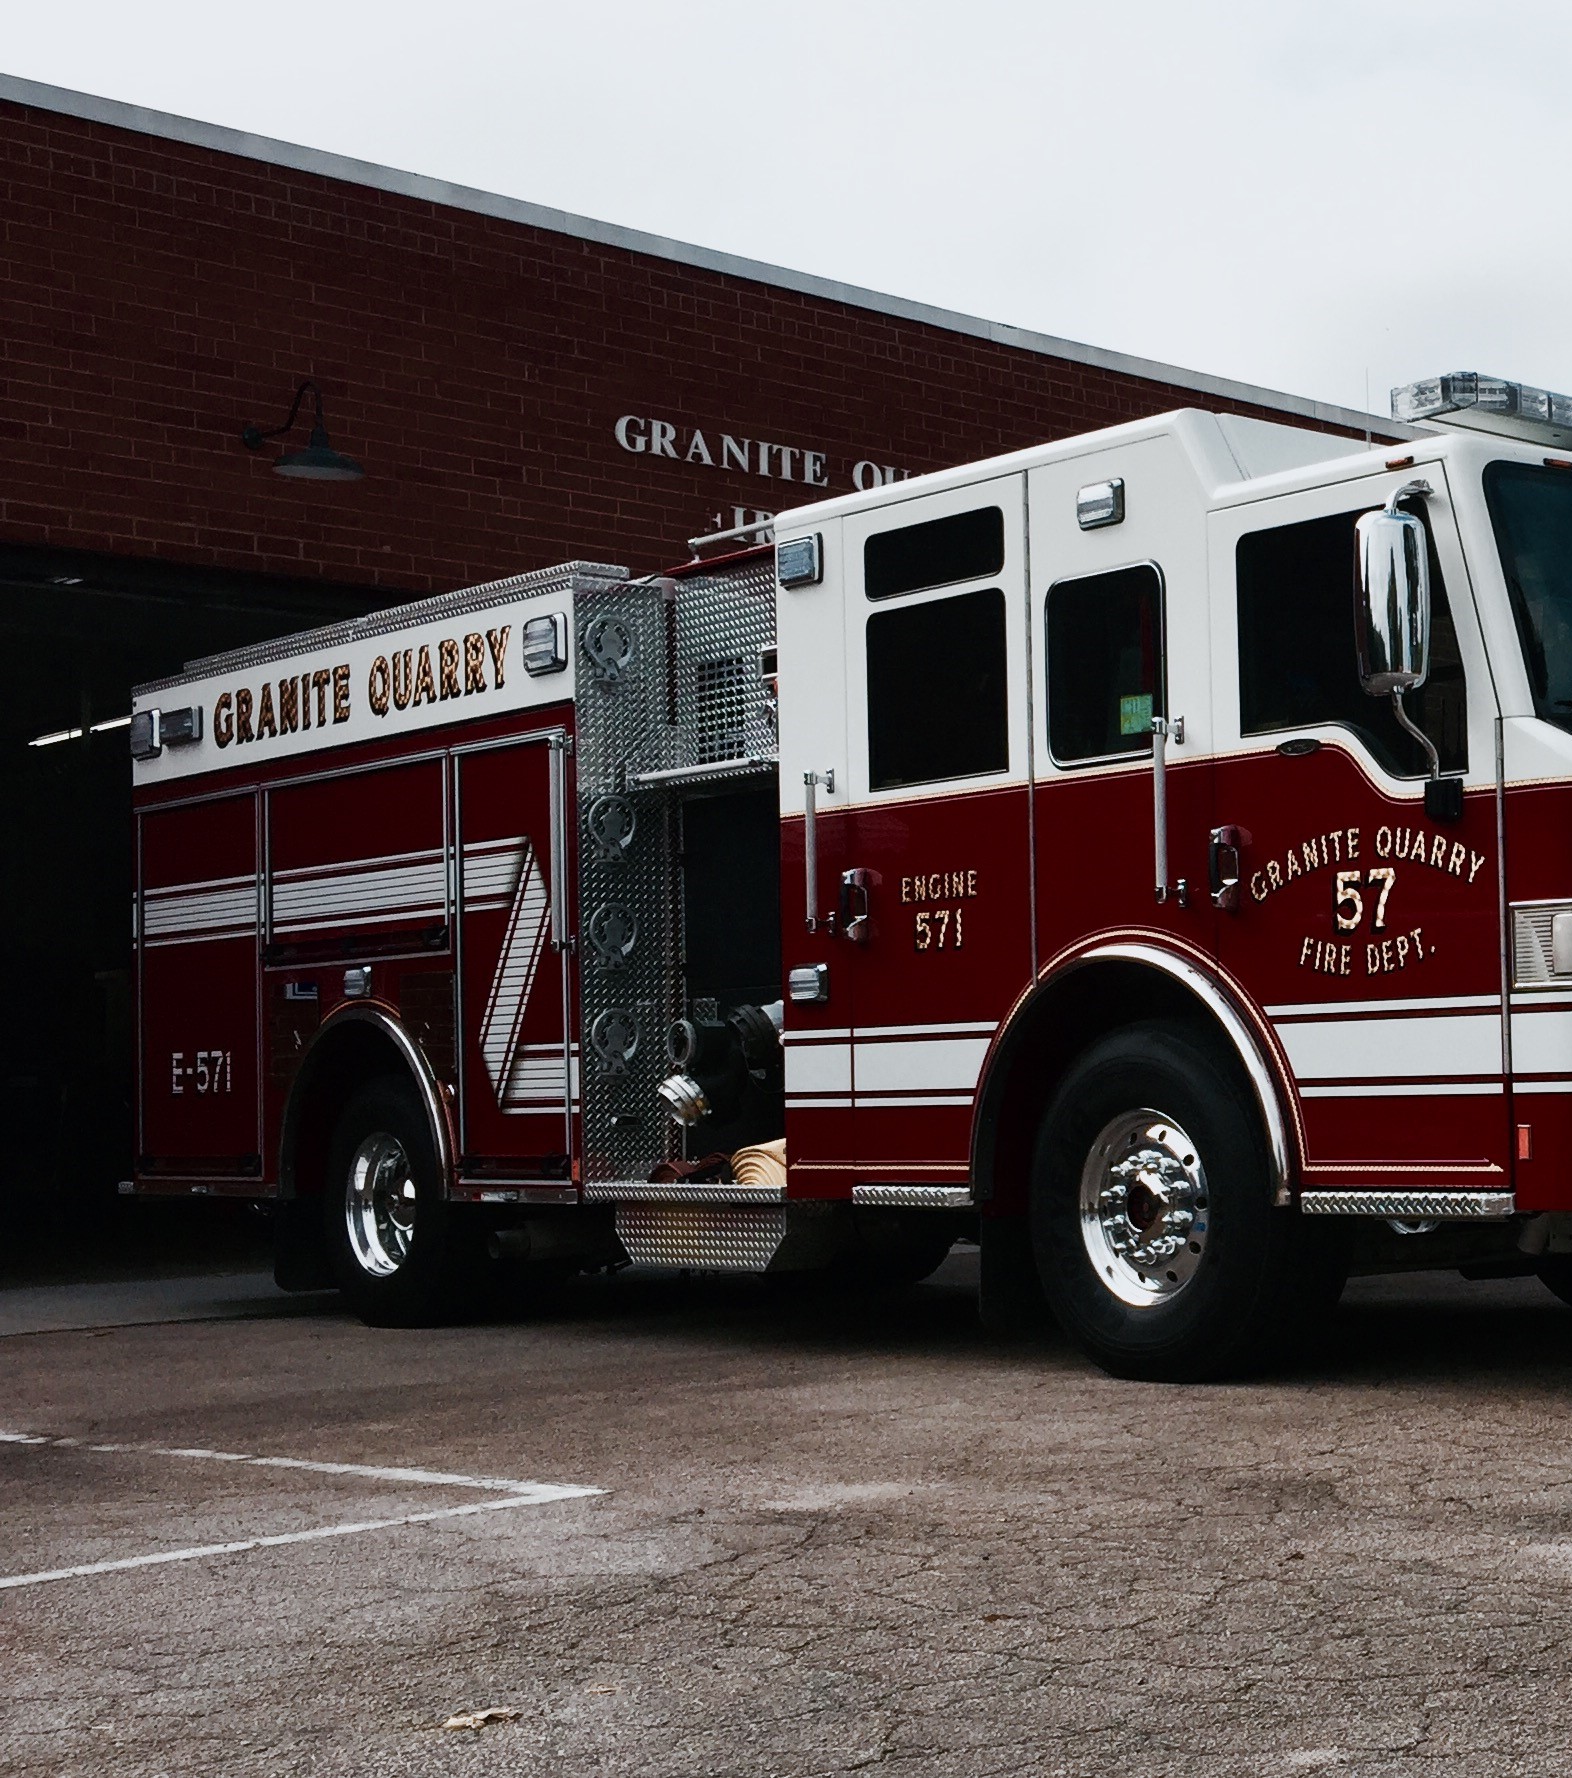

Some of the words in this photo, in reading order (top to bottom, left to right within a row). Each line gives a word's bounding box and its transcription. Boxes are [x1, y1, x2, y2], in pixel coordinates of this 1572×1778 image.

[614, 414, 829, 488] GRANITE
[213, 664, 351, 749] GRANITE
[368, 625, 511, 718] QUARRY
[901, 870, 978, 903] ENGINE
[1250, 827, 1360, 902] GRANITE
[1376, 825, 1486, 883] QUARRY
[1335, 867, 1397, 931] 57
[915, 908, 962, 950] 571
[1300, 936, 1352, 975] FIRE
[1367, 927, 1436, 975] DEPT.
[172, 1051, 231, 1094] E-571
